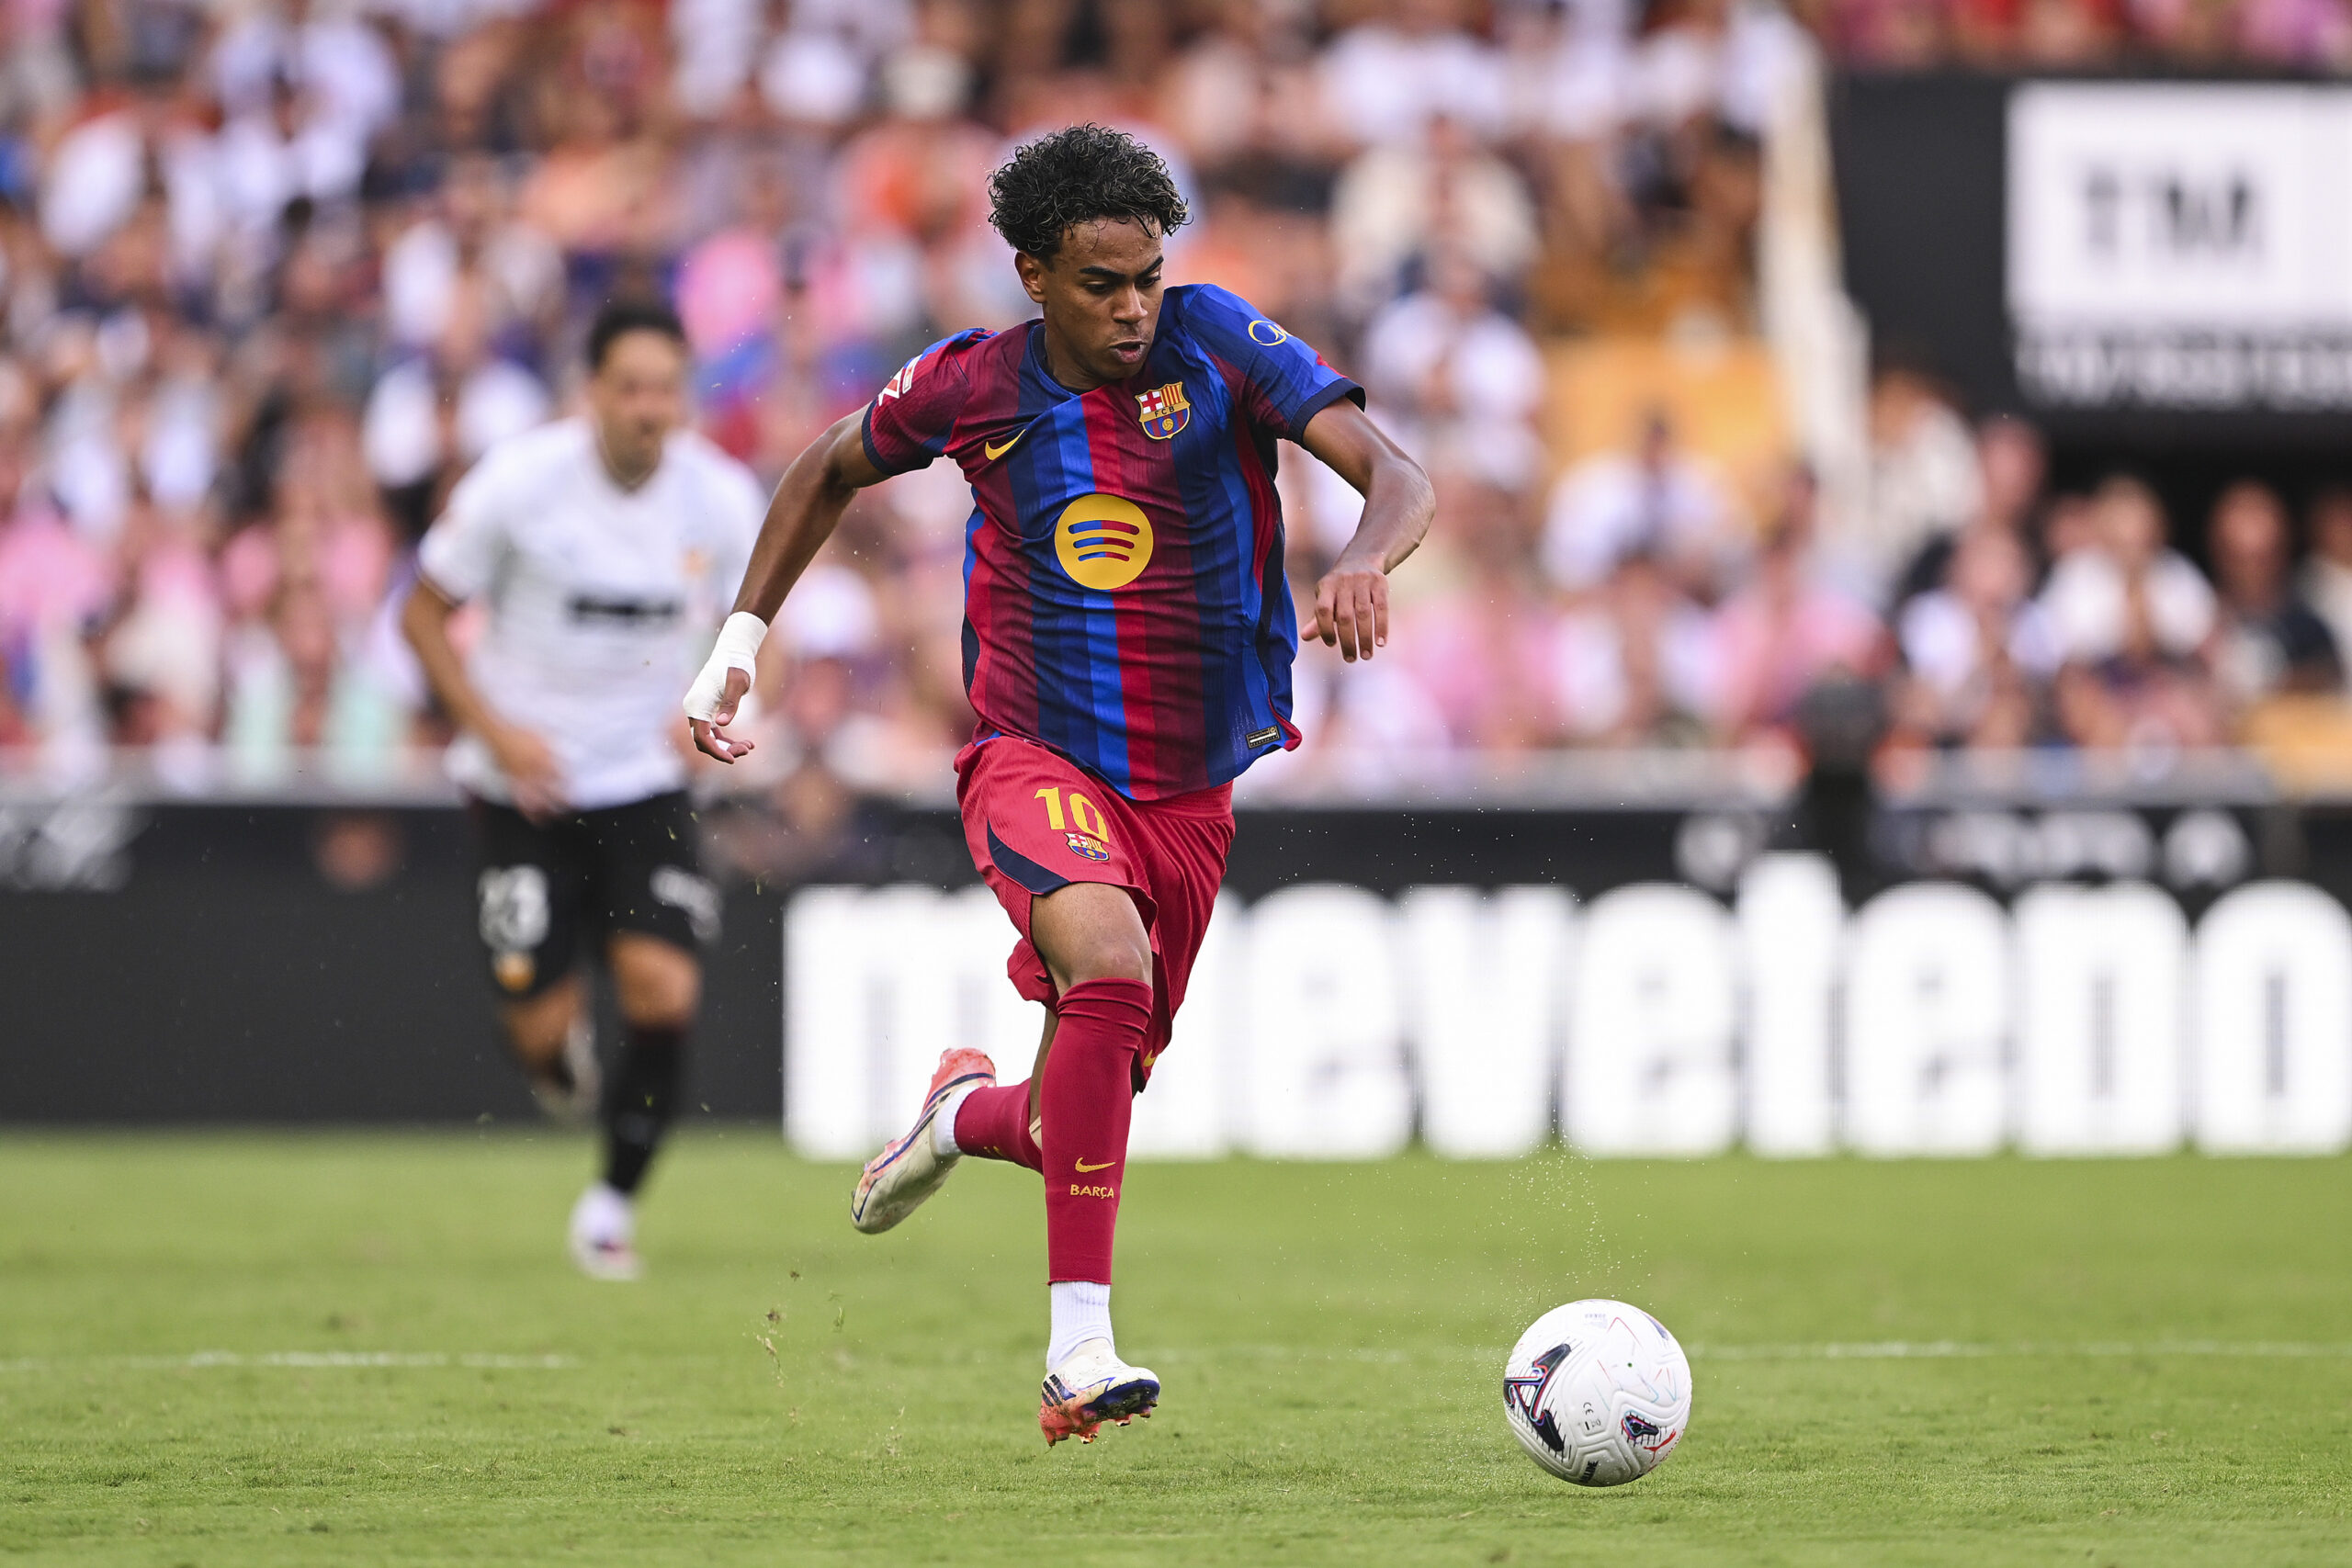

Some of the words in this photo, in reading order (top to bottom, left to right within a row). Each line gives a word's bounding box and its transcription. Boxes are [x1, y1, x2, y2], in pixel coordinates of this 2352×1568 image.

[1155, 405, 1175, 417] FCB
[1034, 786, 1110, 843] 10
[1069, 1183, 1114, 1200] BARÇA
